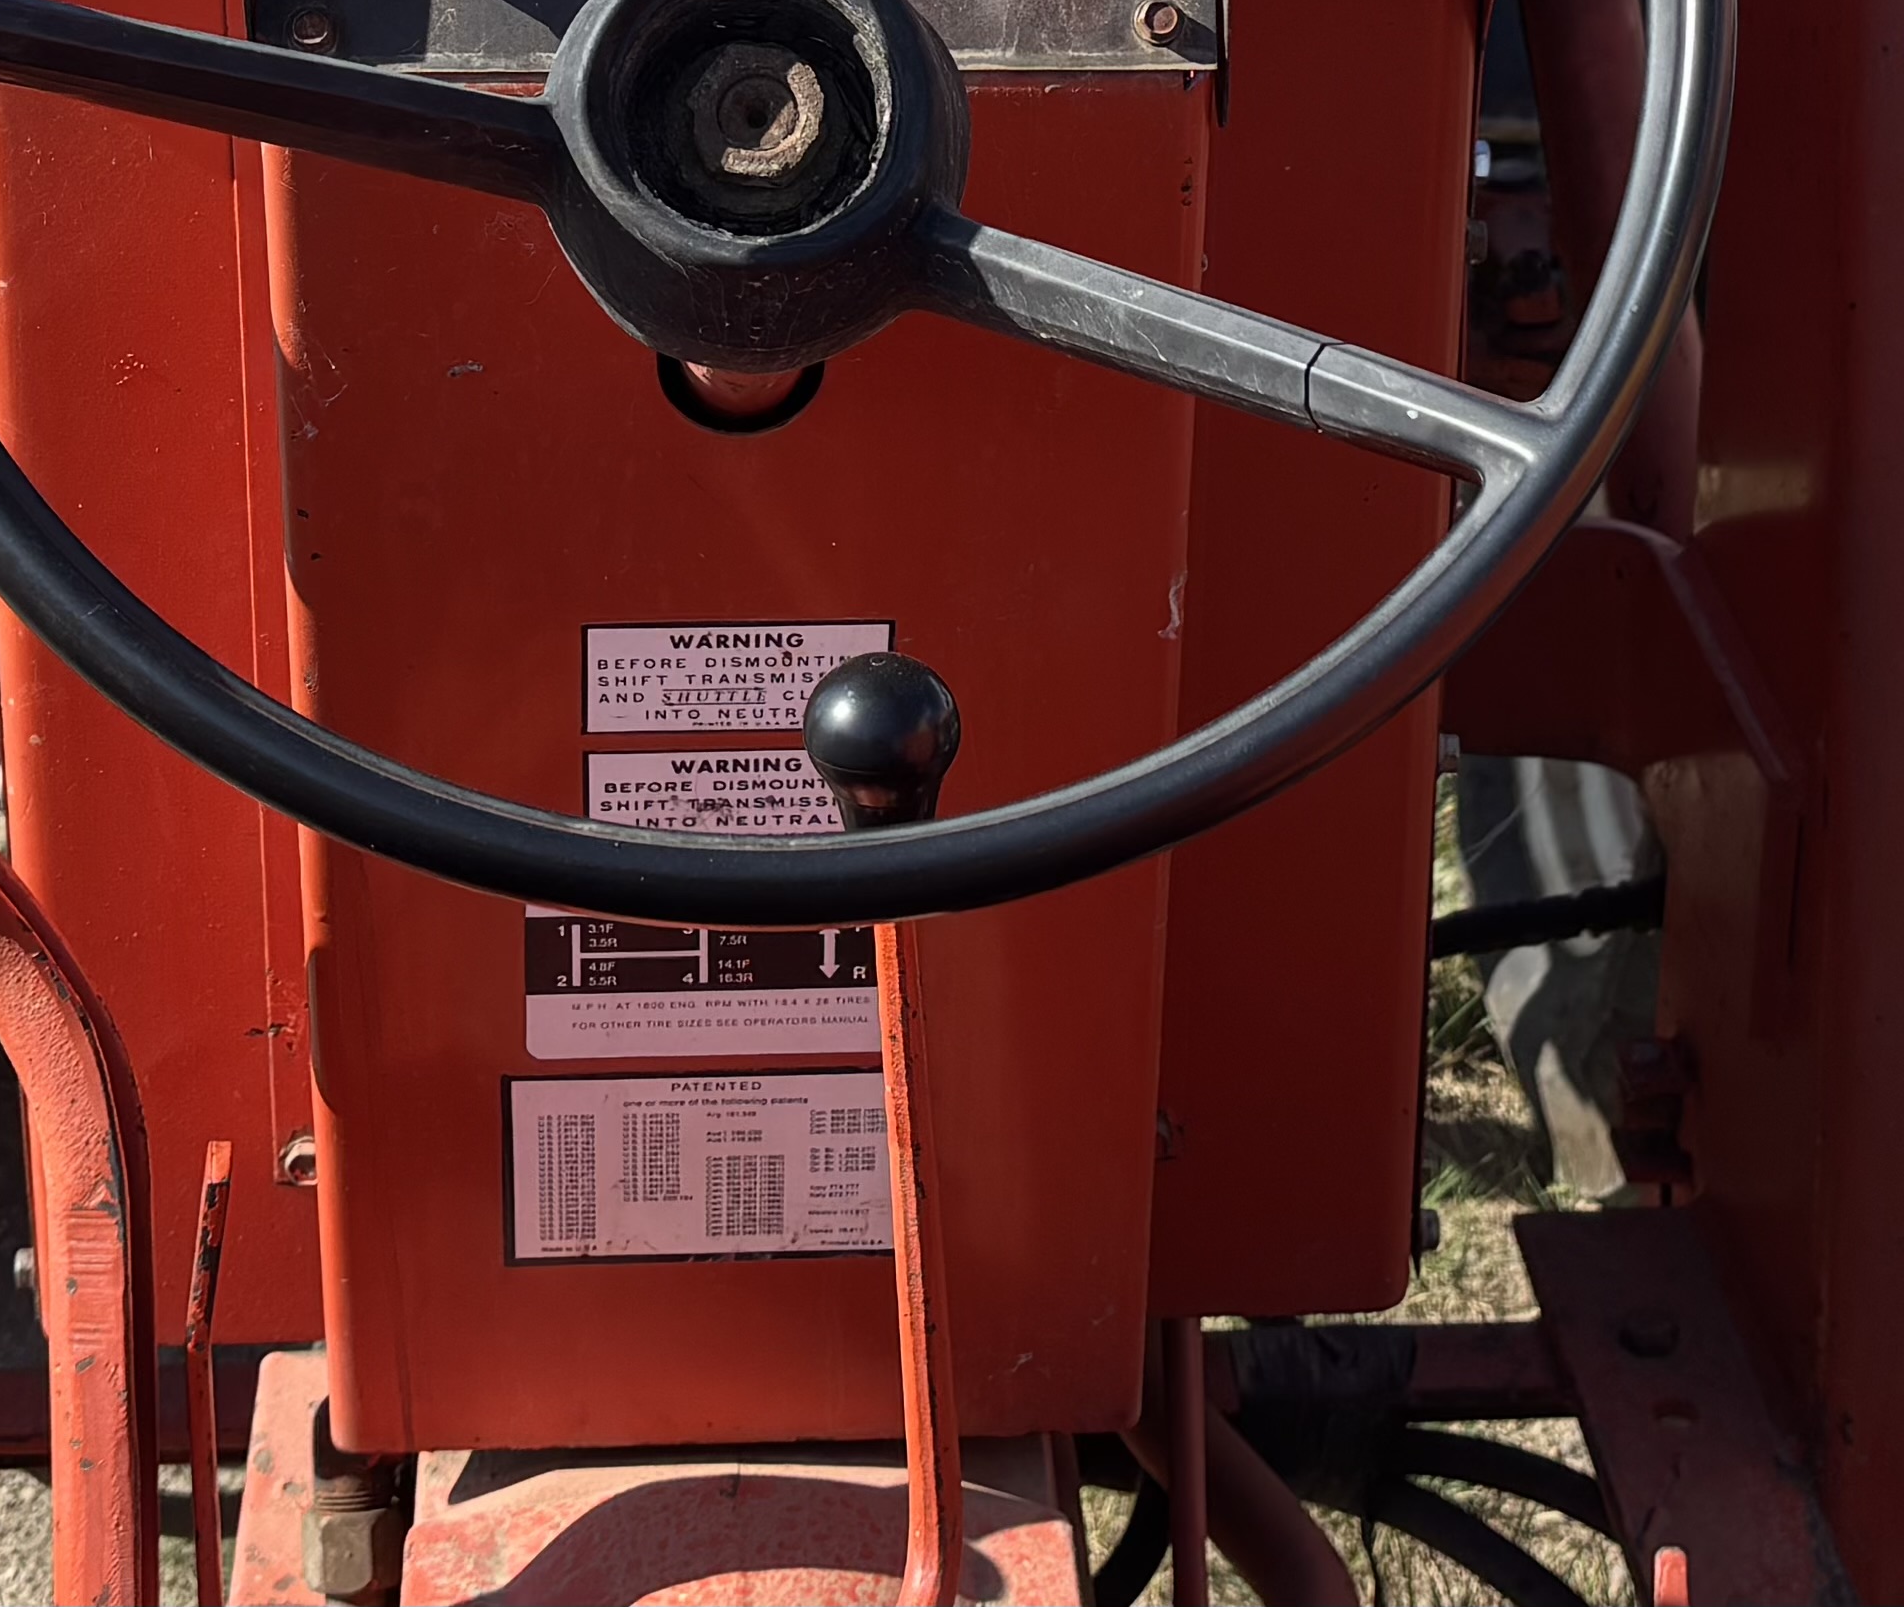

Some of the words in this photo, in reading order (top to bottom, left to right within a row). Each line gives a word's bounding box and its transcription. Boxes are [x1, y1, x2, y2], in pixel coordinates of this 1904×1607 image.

[669, 633, 804, 650] WARNING
[597, 658, 687, 670] BEFORE
[597, 675, 668, 687] SHIFT
[599, 692, 646, 704] AND
[662, 690, 767, 704] SHUTTLE
[645, 708, 701, 720] INTO
[671, 757, 802, 775] WARNING
[604, 781, 693, 794] BEFORE
[600, 799, 668, 812] SHIFT
[635, 816, 696, 829] INTO
[716, 814, 839, 827] NEUTRAL
[557, 925, 565, 937] 1
[682, 972, 694, 984] 4
[853, 965, 866, 979] R
[557, 975, 568, 987] 2
[737, 998, 769, 1007] WITH
[835, 996, 870, 1005] TIRES
[571, 1021, 596, 1031] FOR
[600, 1020, 641, 1030] OTHER
[647, 1019, 672, 1029] TIRE
[677, 1018, 712, 1028] SIZES
[716, 1018, 739, 1027] SEE
[743, 1016, 817, 1027] OPERATORS
[821, 1014, 868, 1024] MANUAL
[670, 1081, 762, 1092] PATENTED
